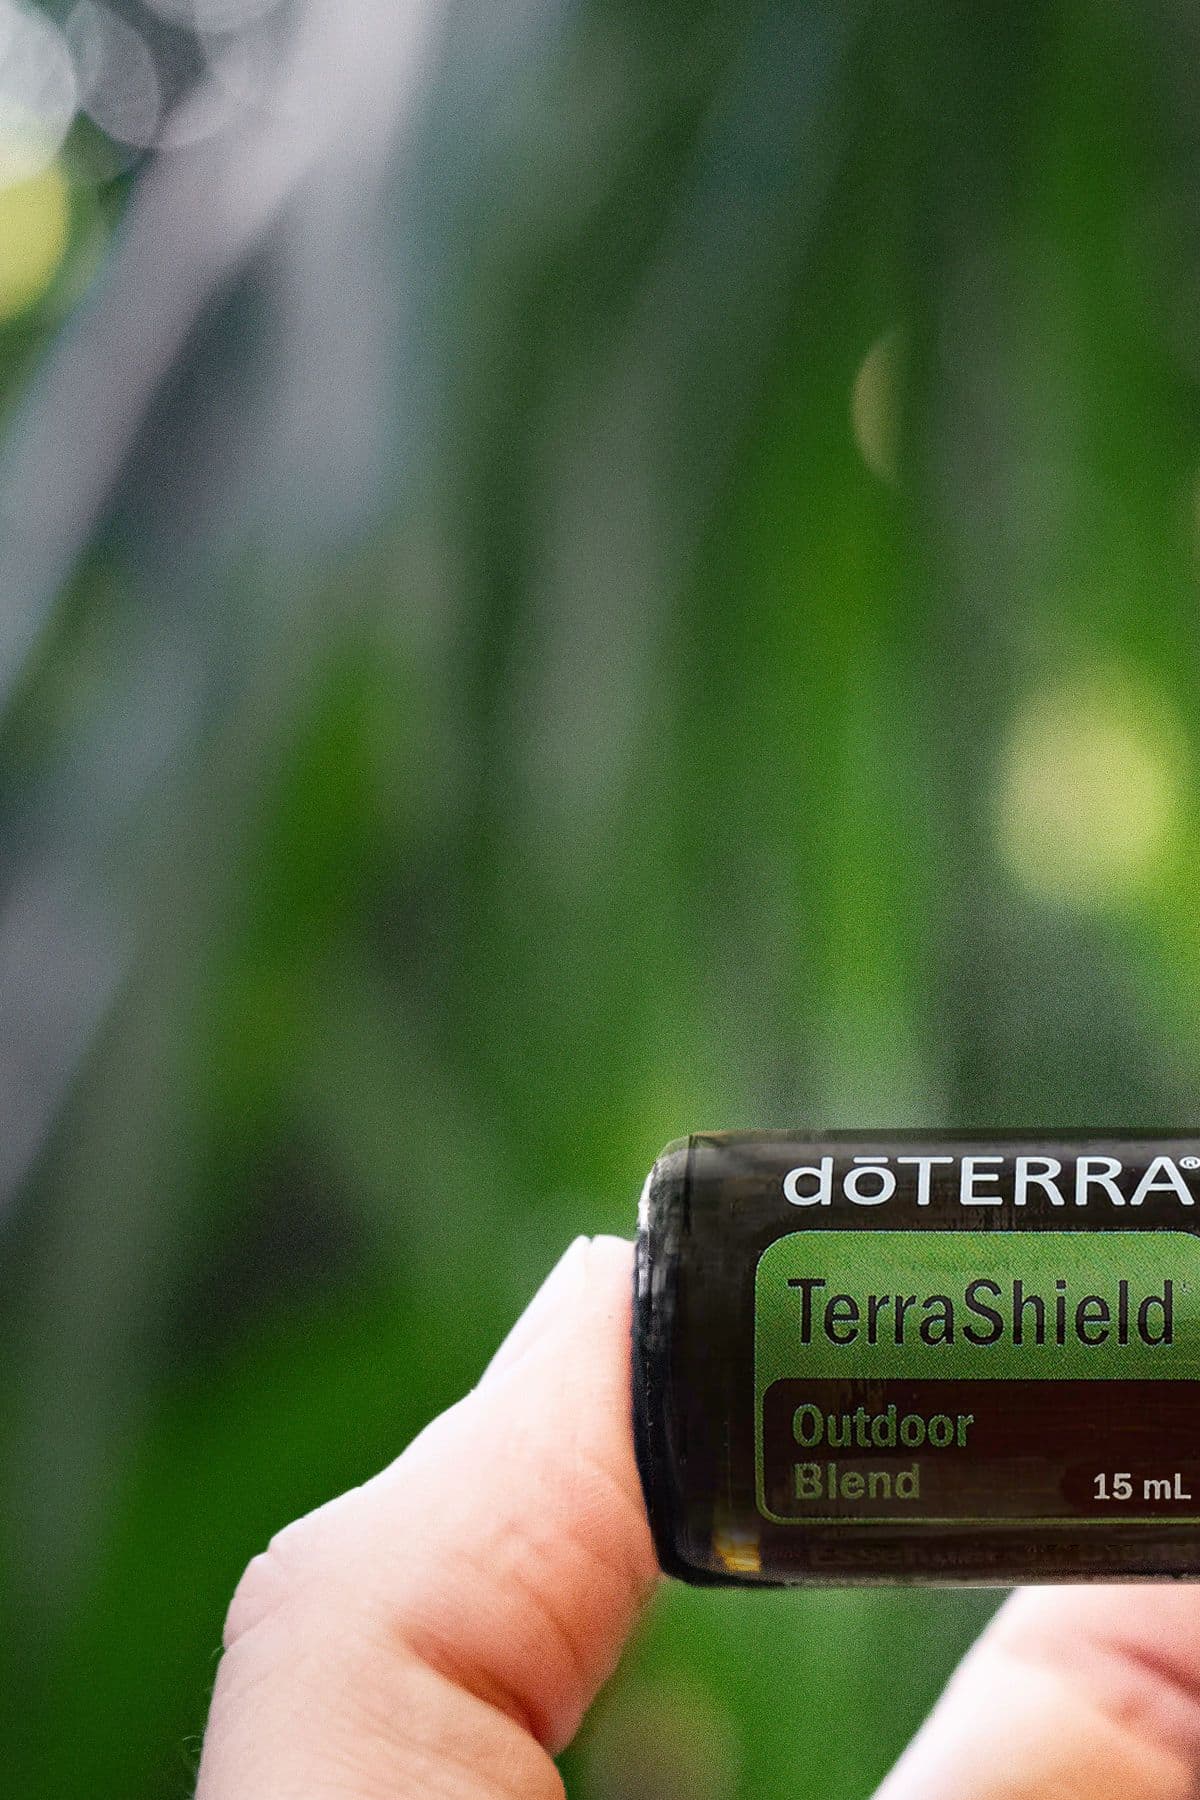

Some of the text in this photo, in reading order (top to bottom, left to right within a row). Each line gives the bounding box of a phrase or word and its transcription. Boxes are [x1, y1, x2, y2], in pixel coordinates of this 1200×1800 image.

[787, 1279, 1174, 1346] TerraShield
[792, 1404, 974, 1448] Outdoor
[793, 1463, 921, 1500] Blend
[1093, 1473, 1192, 1500] 15 mL
